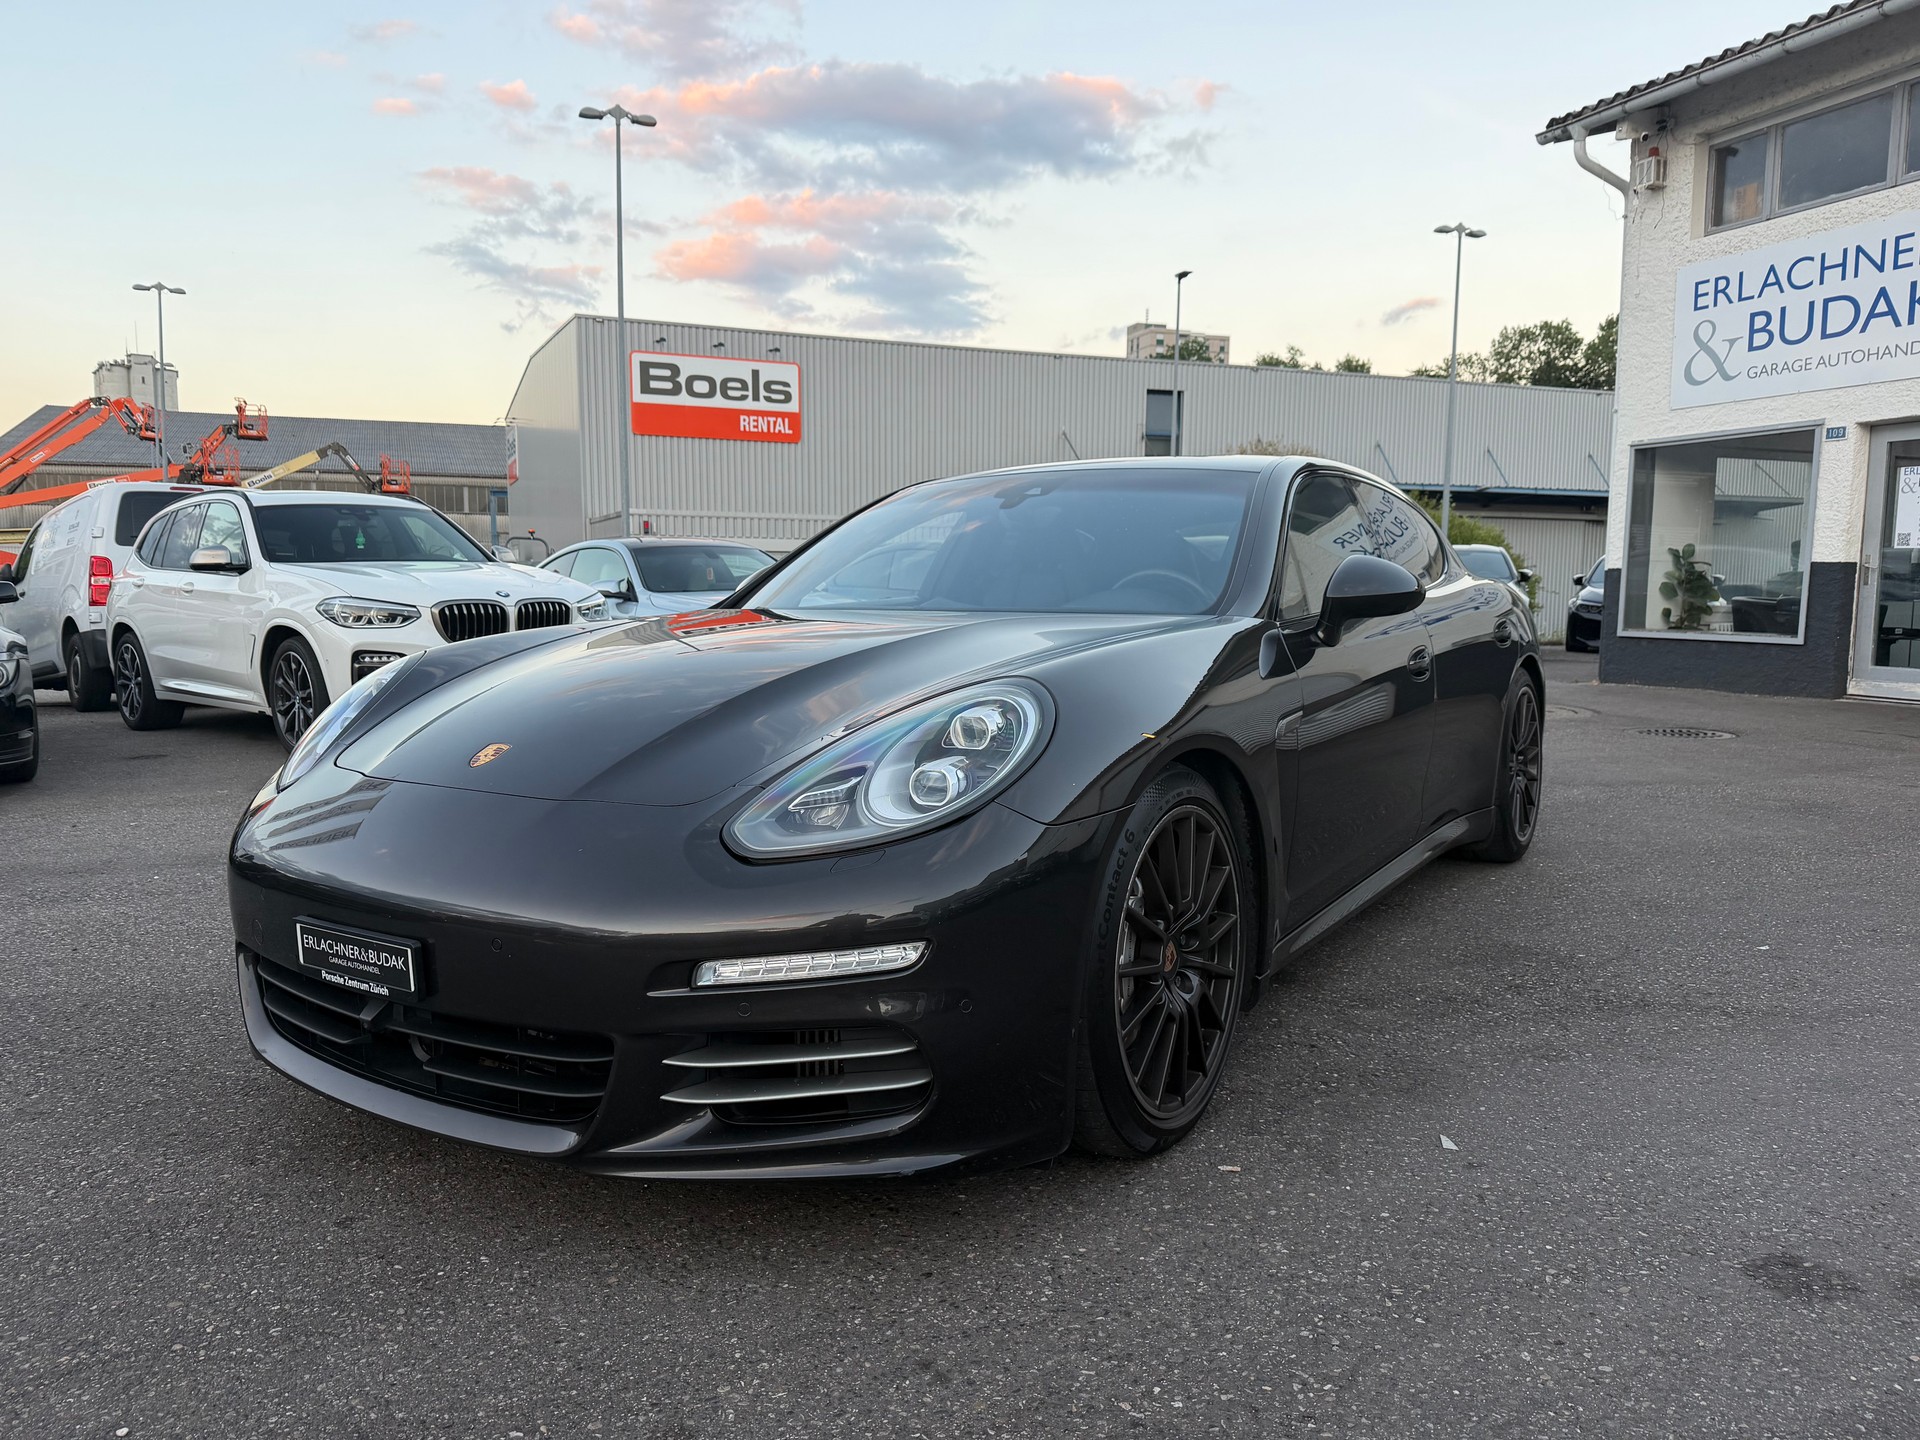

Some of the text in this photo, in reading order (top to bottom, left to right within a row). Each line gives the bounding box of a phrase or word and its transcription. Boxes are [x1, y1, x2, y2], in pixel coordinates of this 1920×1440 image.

[1693, 232, 1920, 312] ERLACHNE
[1683, 319, 1744, 387] &
[1746, 357, 1813, 379] GARAGE
[639, 360, 793, 404] Boels
[740, 415, 793, 434] RENTAL
[1828, 427, 1845, 438] 109
[1124, 828, 1135, 844] 6
[328, 956, 381, 975] GARAGE AUTOHANDEL
[321, 970, 389, 996] Porsche Zentrum Zürich
